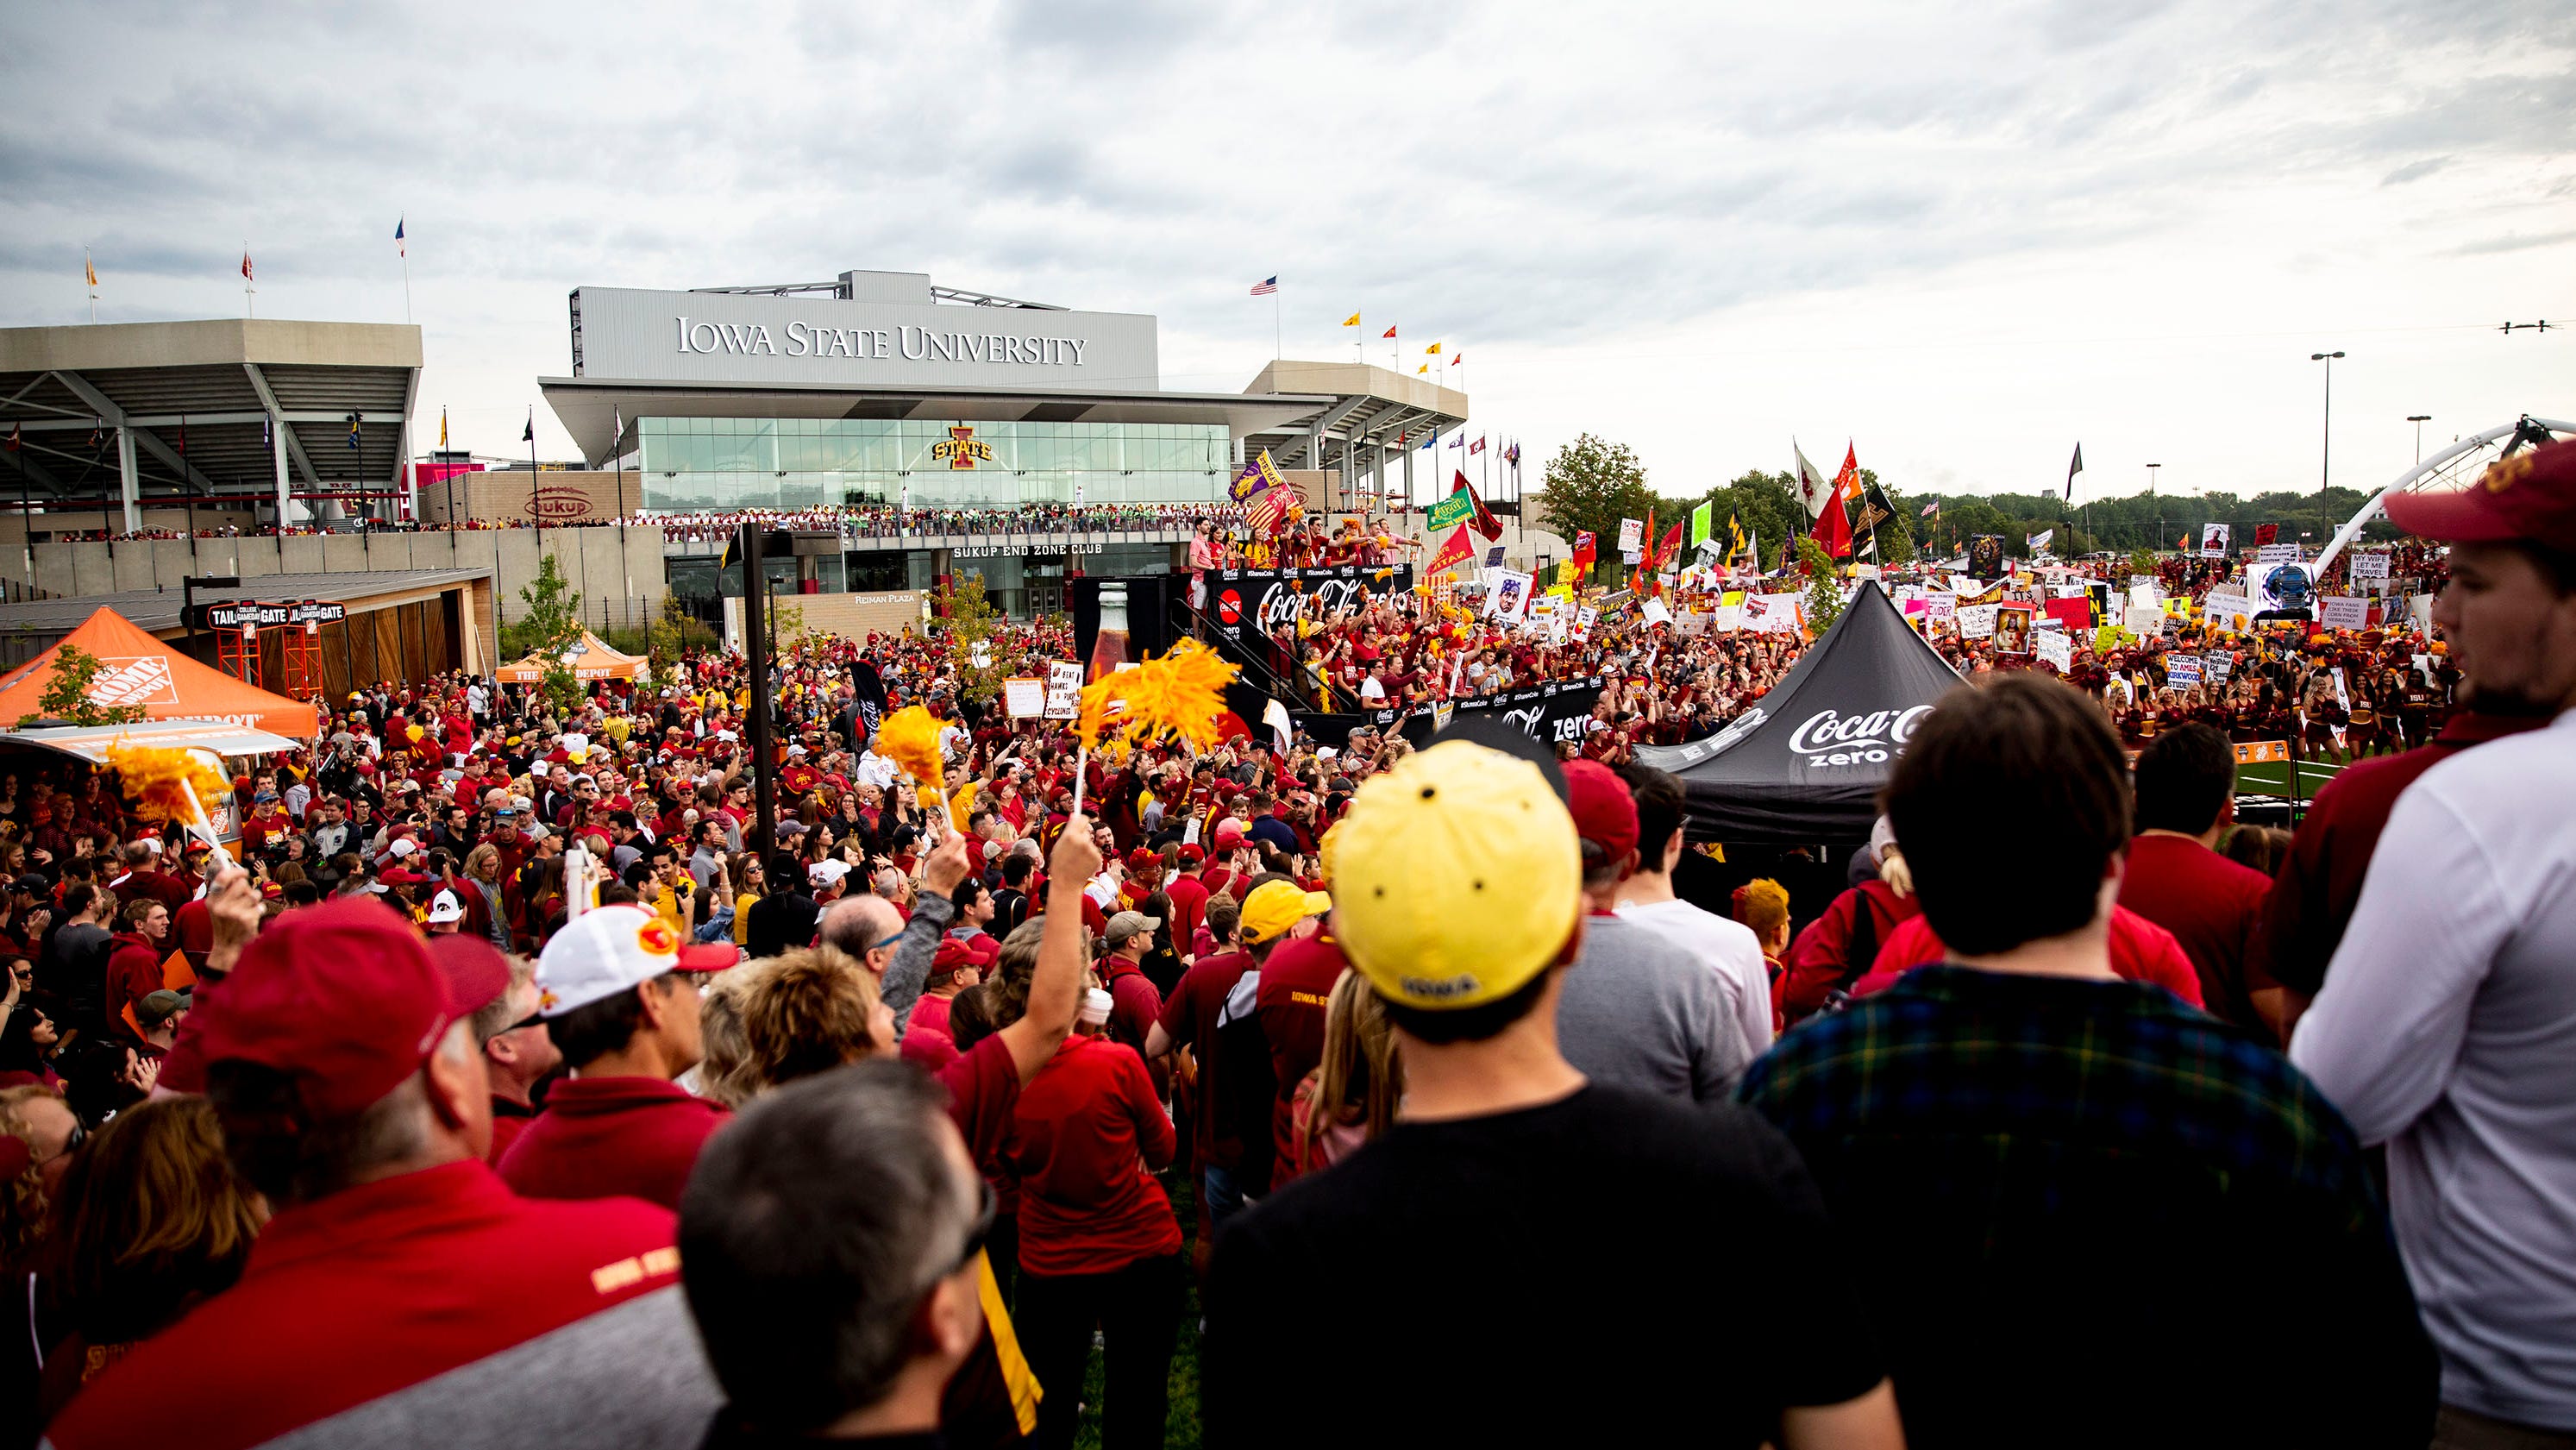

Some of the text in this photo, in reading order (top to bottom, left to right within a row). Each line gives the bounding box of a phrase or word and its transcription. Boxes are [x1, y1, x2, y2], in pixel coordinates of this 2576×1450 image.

[676, 317, 1088, 366] IOWA STATE UNIVERSITY
[932, 440, 992, 461] STATE
[531, 497, 586, 516] Sukup
[954, 544, 1103, 558] SUKUP END ZONE CLUB
[855, 594, 915, 605] REIMAN PLAZA
[212, 609, 286, 625] TAIL GATE
[320, 606, 343, 620] GATE
[2166, 655, 2198, 664] WELCOME
[89, 657, 166, 707] HOME
[516, 670, 539, 681] THE
[575, 669, 612, 678] DEPOT
[2167, 672, 2200, 681] KIRKWOOD
[1789, 705, 1936, 753] Coca-C
[1810, 750, 1888, 767] zero
[1292, 991, 1317, 1005] IOWA
